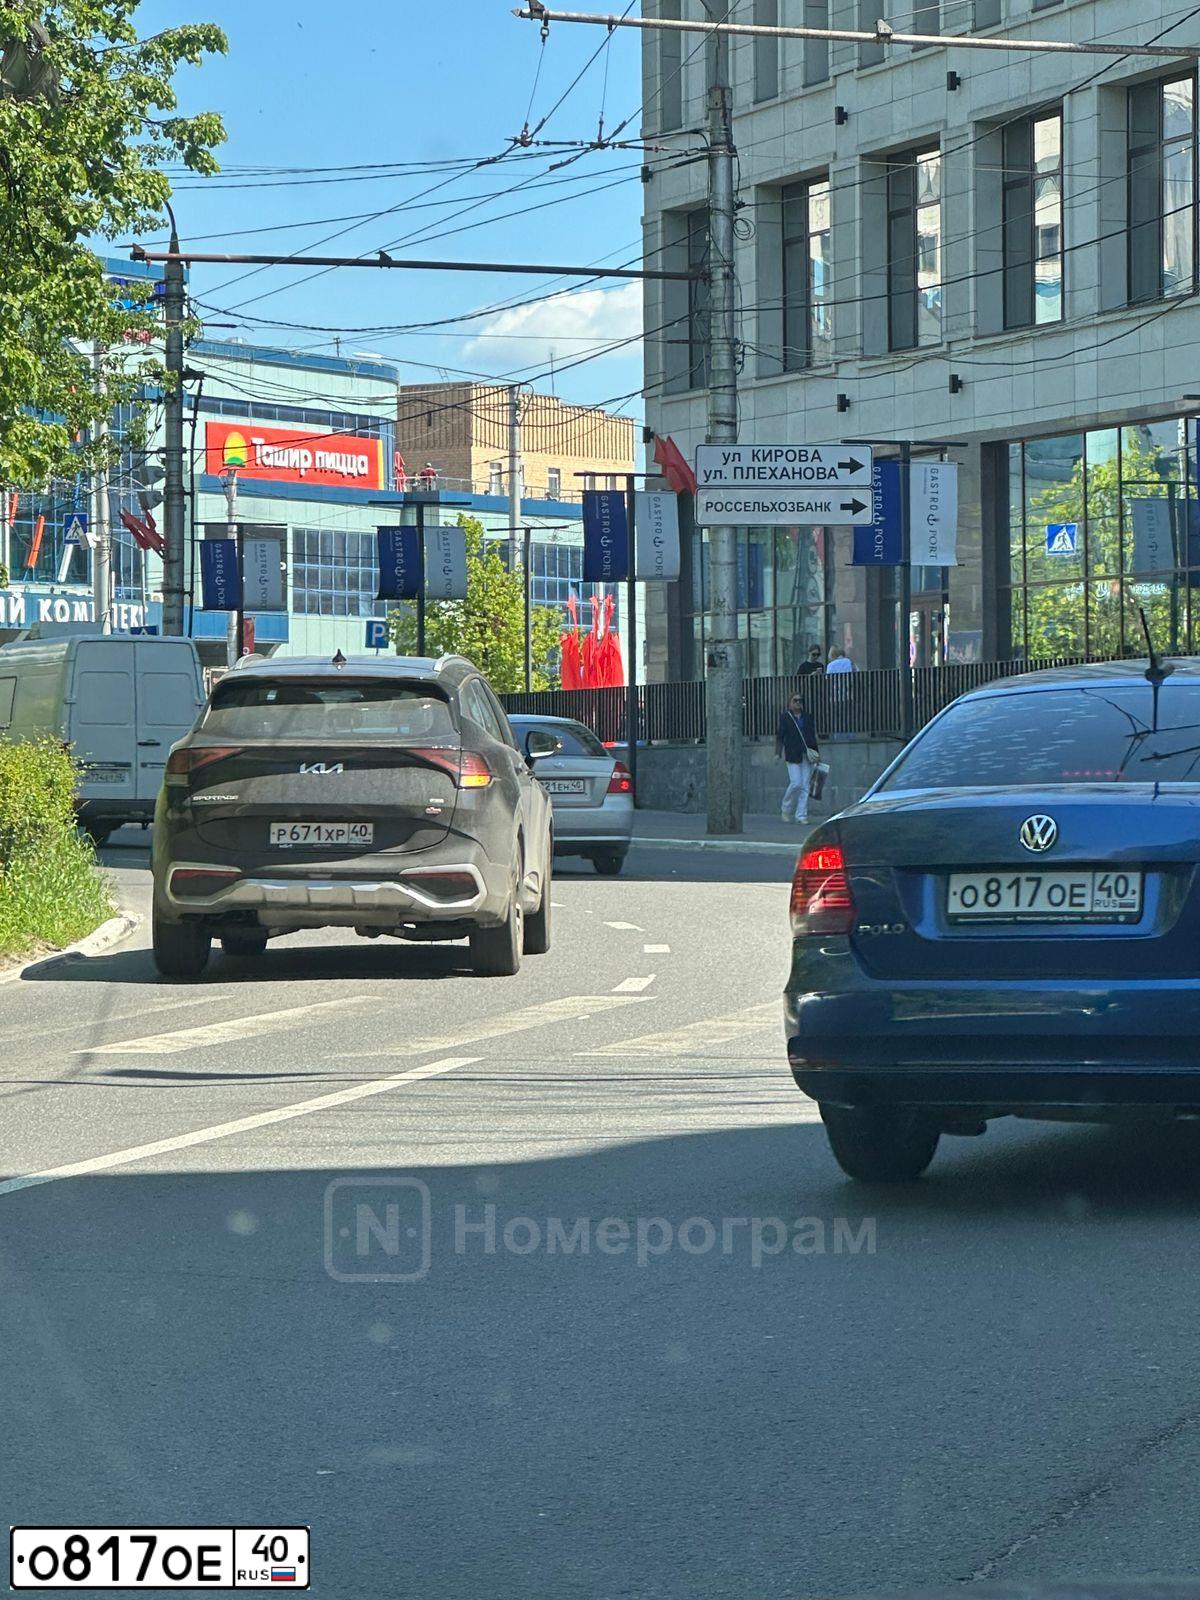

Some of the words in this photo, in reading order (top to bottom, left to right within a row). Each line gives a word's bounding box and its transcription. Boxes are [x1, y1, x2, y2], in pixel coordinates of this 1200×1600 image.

[250, 437, 313, 477] Ташир
[314, 450, 369, 478] пицца
[722, 451, 741, 465] ул
[752, 449, 822, 463] КИРОВА
[703, 469, 727, 483] ул.
[733, 466, 839, 480] ПЛЕХАНОВА
[872, 466, 883, 510] GASTRO
[929, 468, 939, 511] GASTRO
[600, 495, 610, 534] GASTRO
[652, 496, 662, 534] GASTRO
[705, 501, 832, 513] РОССЕЛЬХОЗБАНК
[214, 543, 224, 575] GASTRO
[259, 543, 268, 574] GASTRO
[394, 530, 404, 566] GASTRO
[441, 530, 452, 566] GASTRO
[874, 528, 884, 560] PORT
[928, 530, 938, 560] PORT
[602, 550, 611, 576] PORT
[371, 623, 385, 646] P
[351, 824, 368, 837] 40
[1097, 874, 1129, 898] 40
[1094, 899, 1118, 908] RUS
[858, 924, 904, 936] POLO
